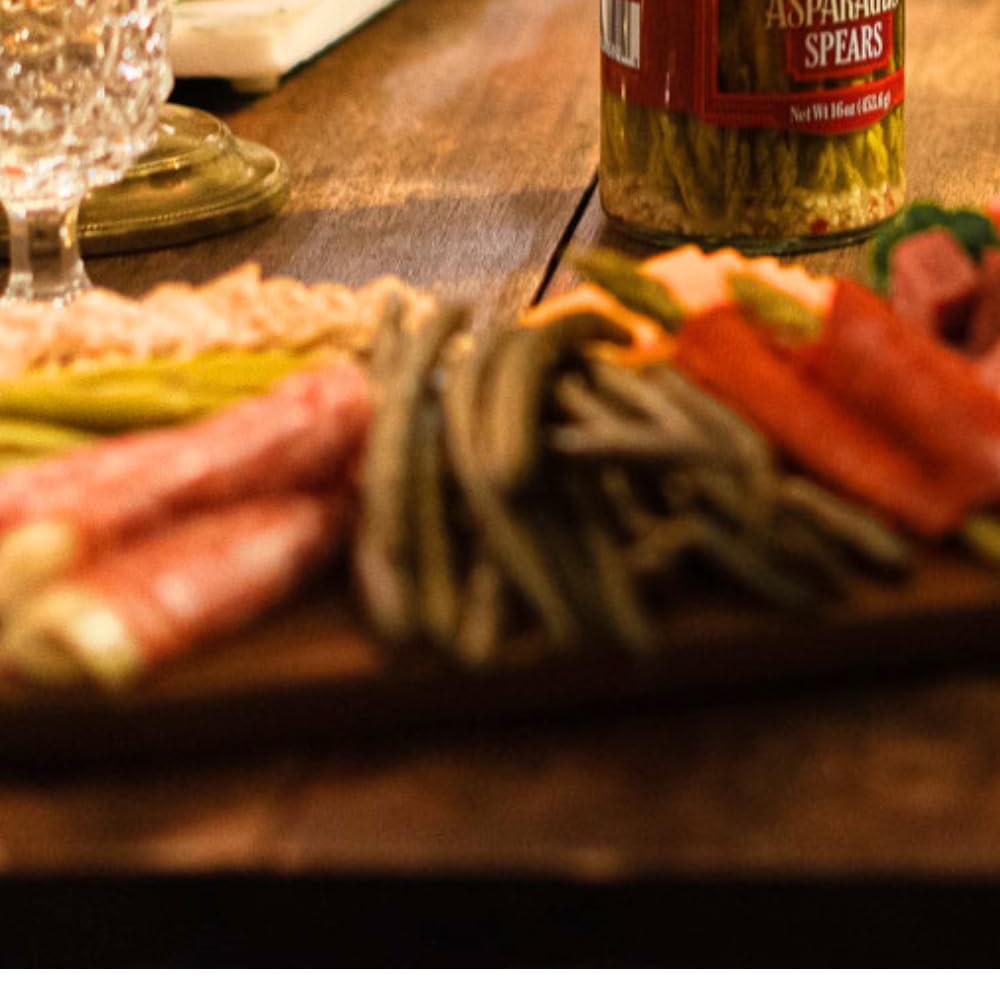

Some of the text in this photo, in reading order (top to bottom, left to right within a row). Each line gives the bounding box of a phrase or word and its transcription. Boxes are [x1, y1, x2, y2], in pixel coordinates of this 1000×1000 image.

[804, 21, 883, 69] SPEARS
[790, 105, 811, 122] Net
[813, 102, 828, 120] Wt
